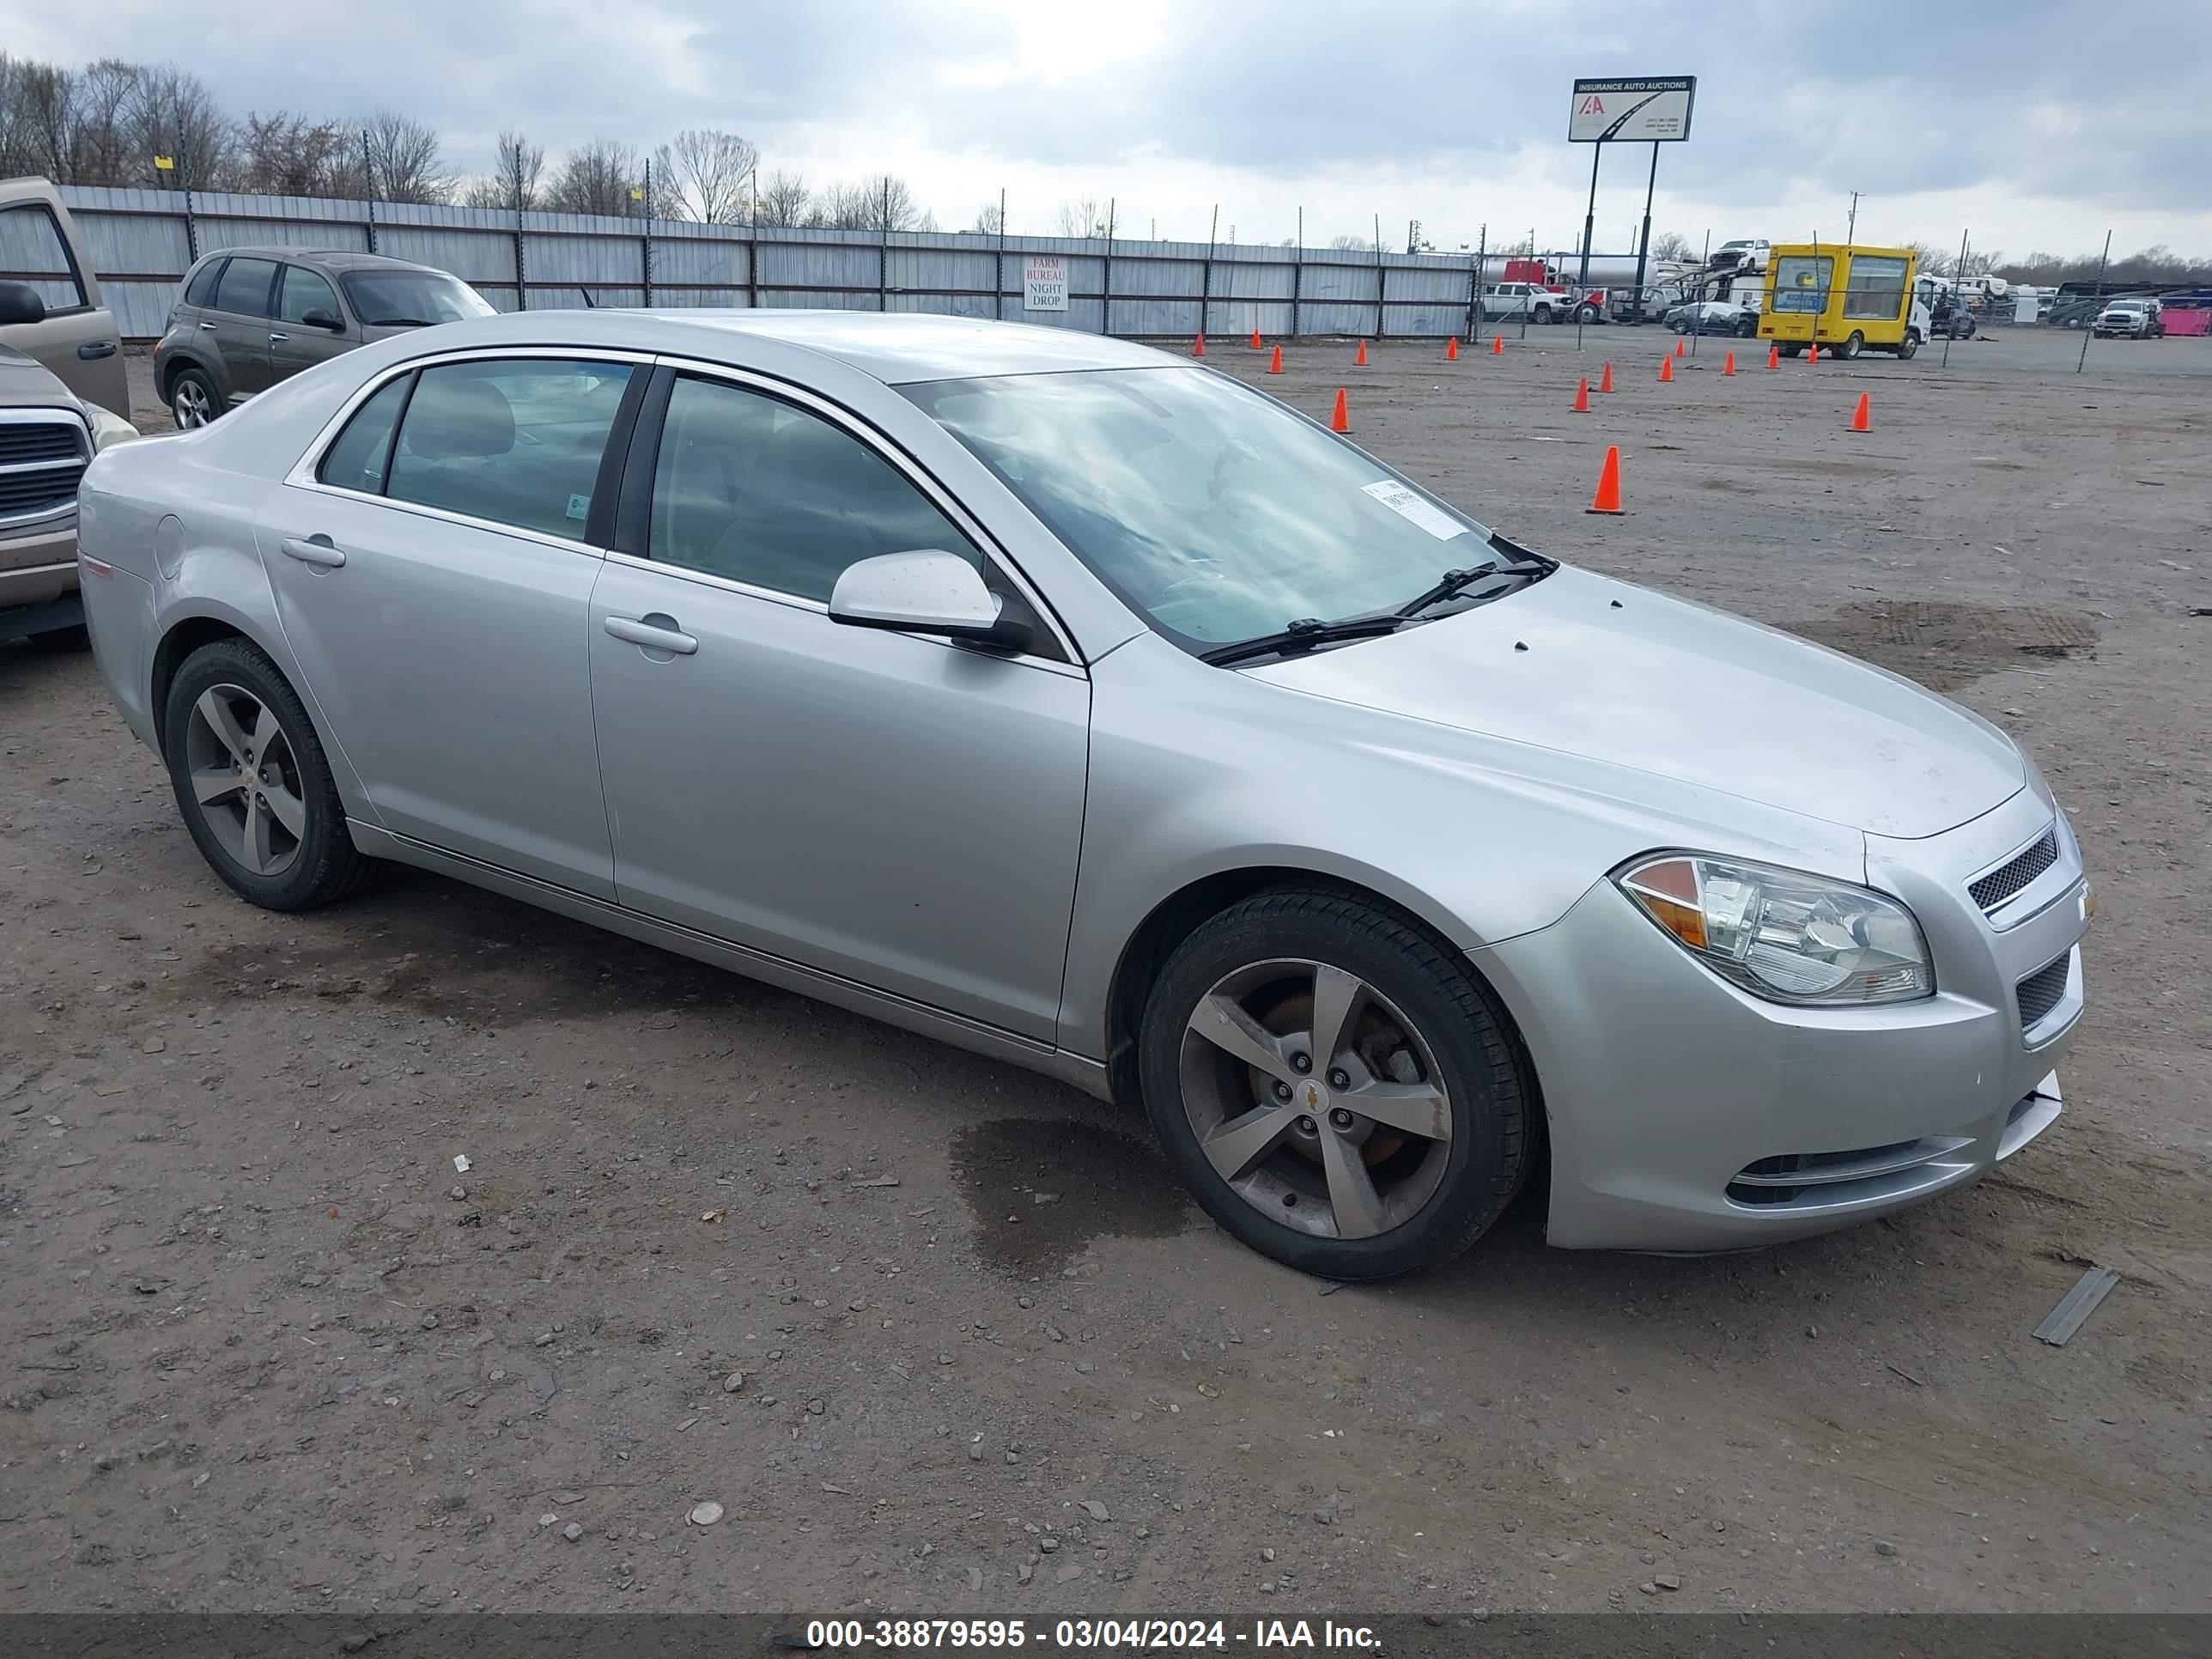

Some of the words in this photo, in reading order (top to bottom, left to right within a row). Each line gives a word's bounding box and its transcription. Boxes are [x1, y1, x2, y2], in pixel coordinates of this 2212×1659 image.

[1578, 82, 1622, 91] INSURANCE
[1624, 82, 1645, 90] AUTO
[1033, 258, 1059, 269] FARM
[1026, 270, 1066, 281] BUREAU
[1030, 283, 1063, 294] NIGHT
[1033, 295, 1060, 306] DROP
